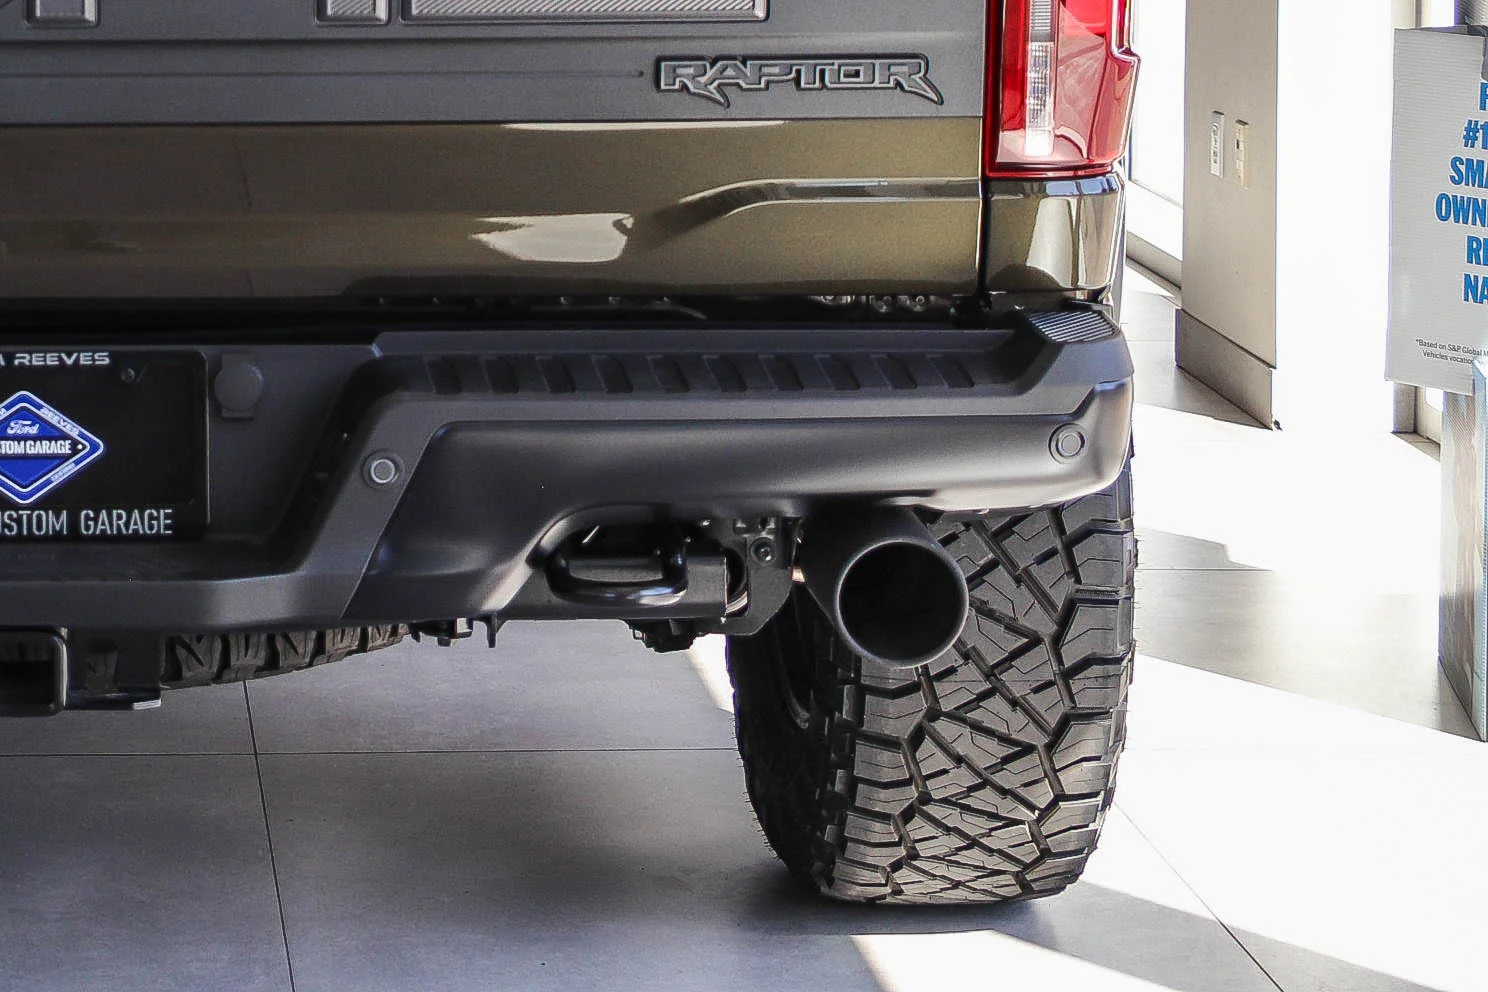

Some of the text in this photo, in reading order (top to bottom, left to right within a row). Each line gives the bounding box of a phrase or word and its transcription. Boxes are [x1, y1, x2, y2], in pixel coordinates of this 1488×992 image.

[657, 55, 944, 108] RAPTOR
[14, 352, 110, 366] REEVES
[6, 419, 40, 434] Ford
[25, 439, 72, 455] GARAGE
[79, 509, 173, 536] GARAGE
